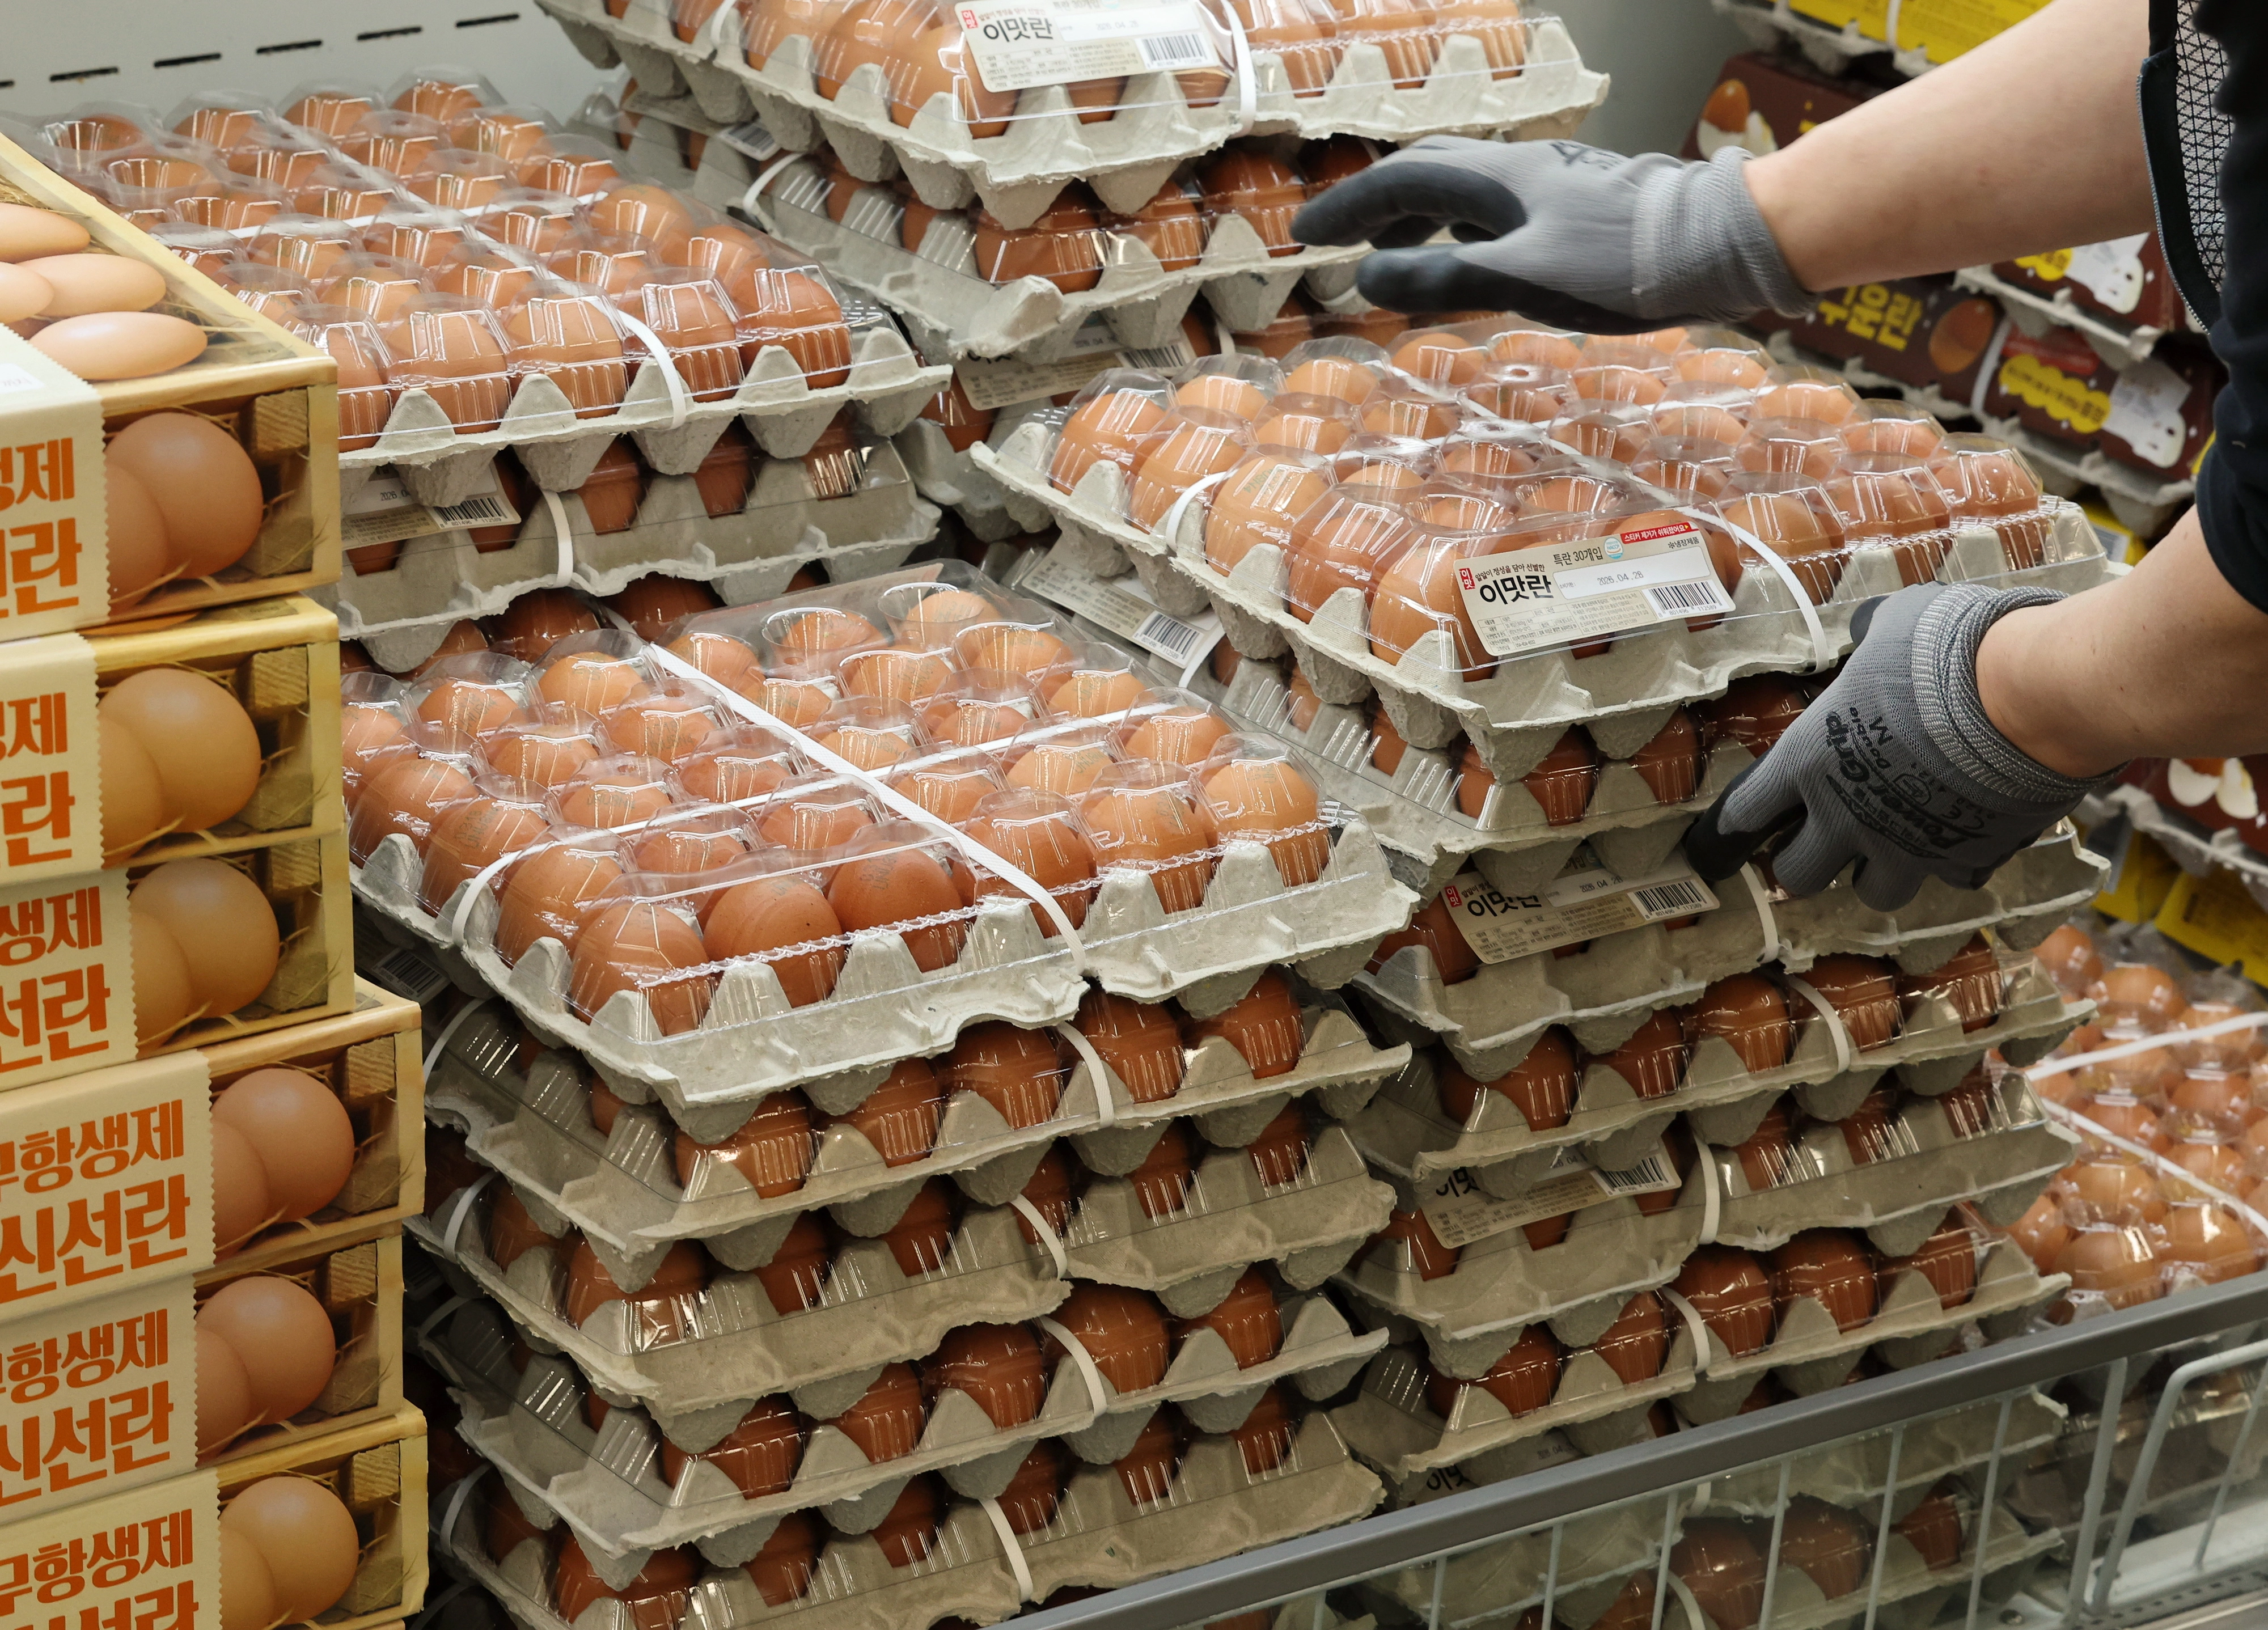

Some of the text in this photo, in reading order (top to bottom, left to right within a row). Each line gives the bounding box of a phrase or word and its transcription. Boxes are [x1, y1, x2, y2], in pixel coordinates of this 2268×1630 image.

[962, 10, 977, 28] 이맛
[983, 17, 1053, 43] 이맛란
[1624, 524, 1686, 541] 스티커 제거가 쉬워졌어요
[0, 518, 82, 619] 란
[1553, 547, 1603, 566] 특란 30개입
[1461, 569, 1475, 589] 이맛
[1475, 564, 1546, 582] 알알이 정성을 담아 선별한
[1597, 570, 1644, 586] 2026.04.28
[1479, 575, 1554, 605] 이맛란
[0, 692, 67, 761] 제
[1868, 716, 1894, 747] M
[1, 770, 75, 867] 란
[1446, 886, 1460, 906] 이맛
[1435, 1166, 1481, 1198] 이맛
[0, 1173, 191, 1304] 신선란
[0, 1308, 168, 1404] 항생제
[0, 1380, 174, 1507] 신선란
